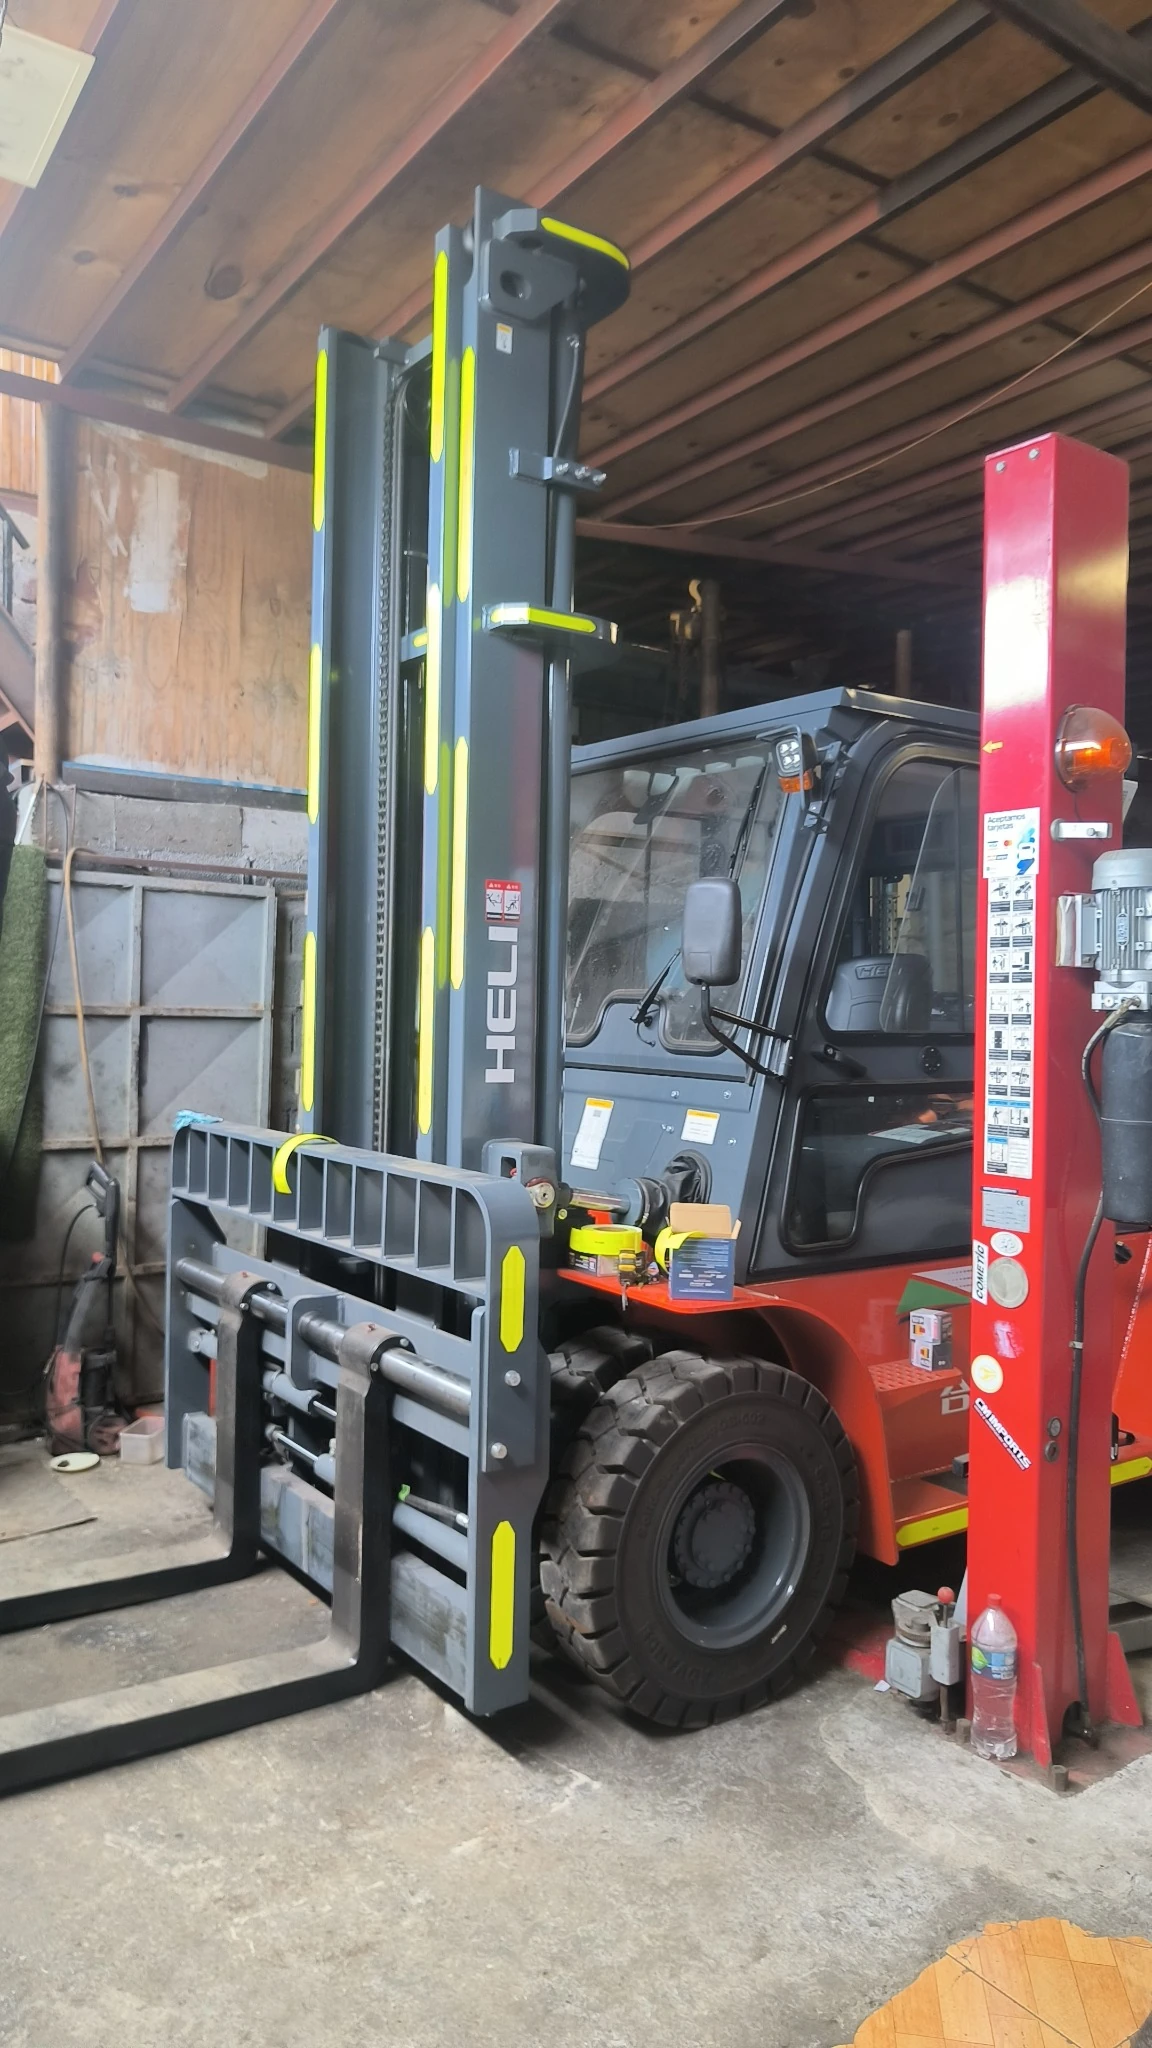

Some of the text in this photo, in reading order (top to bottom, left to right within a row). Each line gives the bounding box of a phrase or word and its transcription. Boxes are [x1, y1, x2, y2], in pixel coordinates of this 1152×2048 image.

[987, 814, 1026, 824] Aceptamos
[987, 823, 1014, 832] tarjetas
[484, 925, 519, 1084] HELI
[976, 1244, 985, 1300] COMETIC
